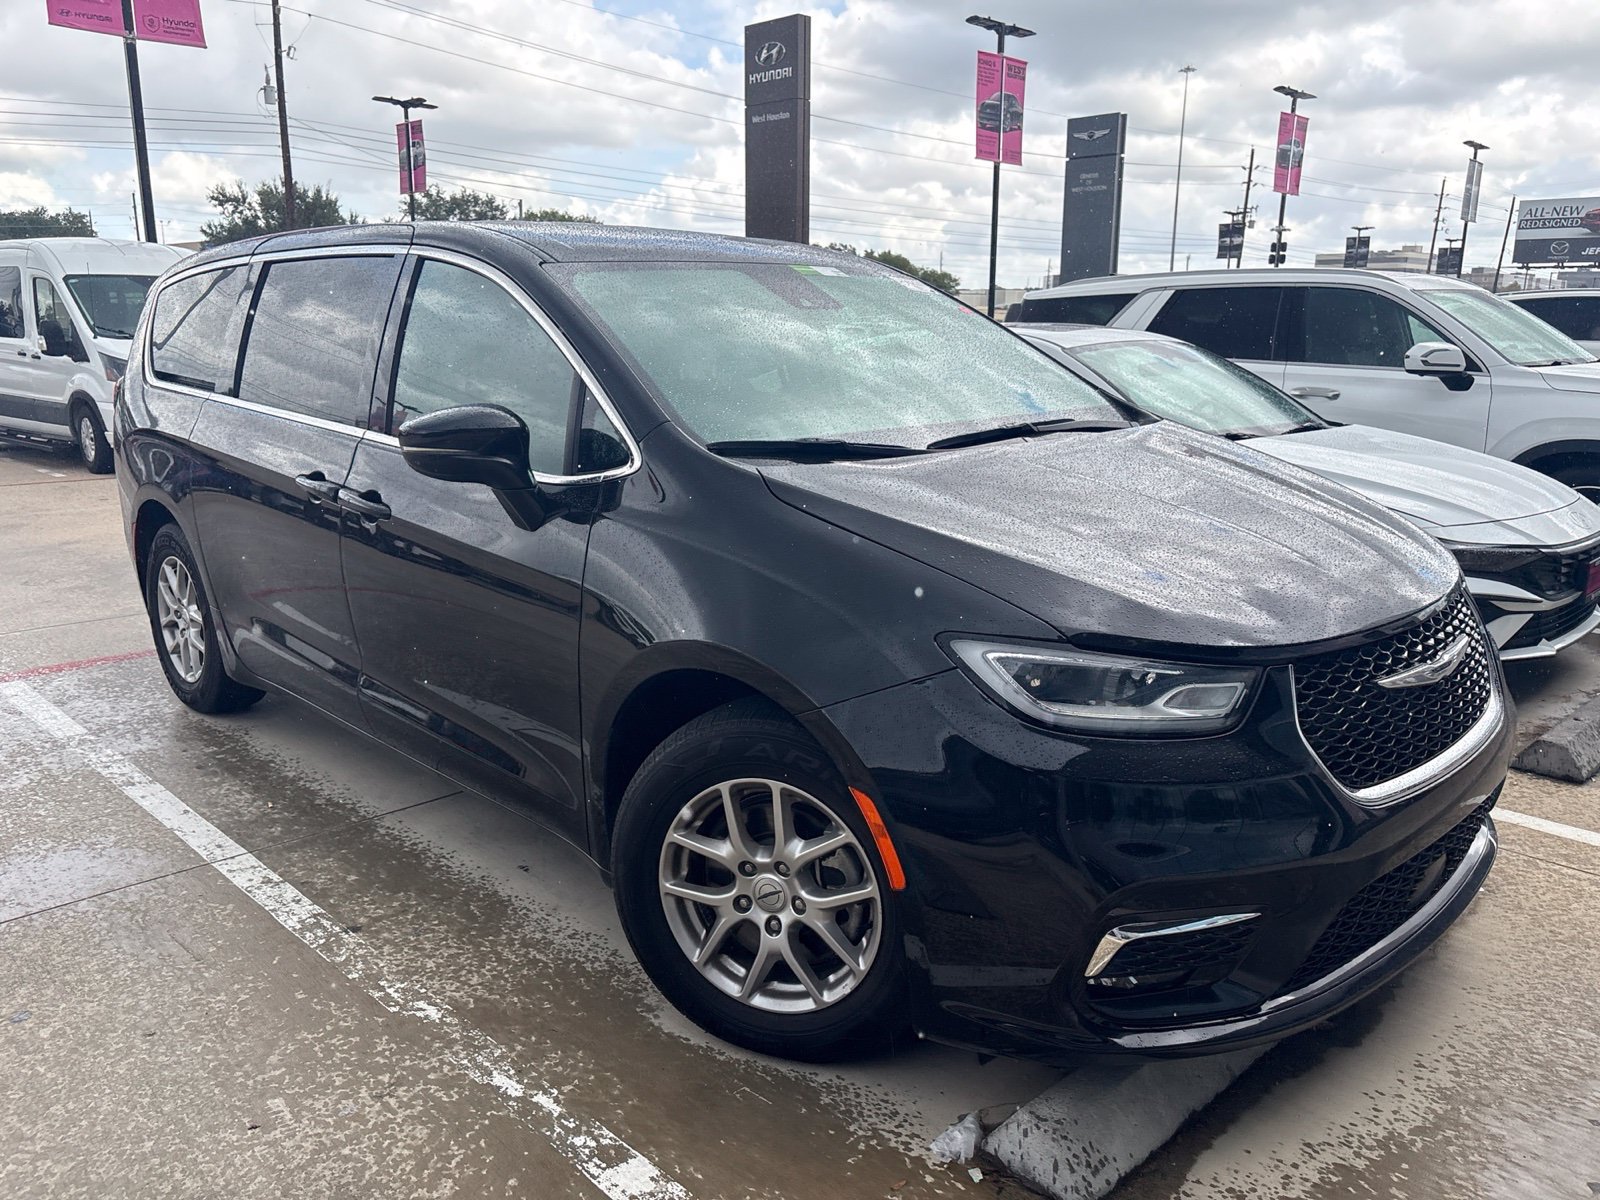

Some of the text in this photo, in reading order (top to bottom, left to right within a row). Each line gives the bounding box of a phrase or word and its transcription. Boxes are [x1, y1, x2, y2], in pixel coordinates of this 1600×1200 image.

[74, 12, 112, 22] HYUNDAI
[162, 17, 196, 27] Hyundai
[749, 67, 792, 84] HYUNDAI
[751, 112, 790, 123] West Houston
[1523, 205, 1585, 218] ALL-NEW
[1520, 218, 1581, 228] REDESIGNED
